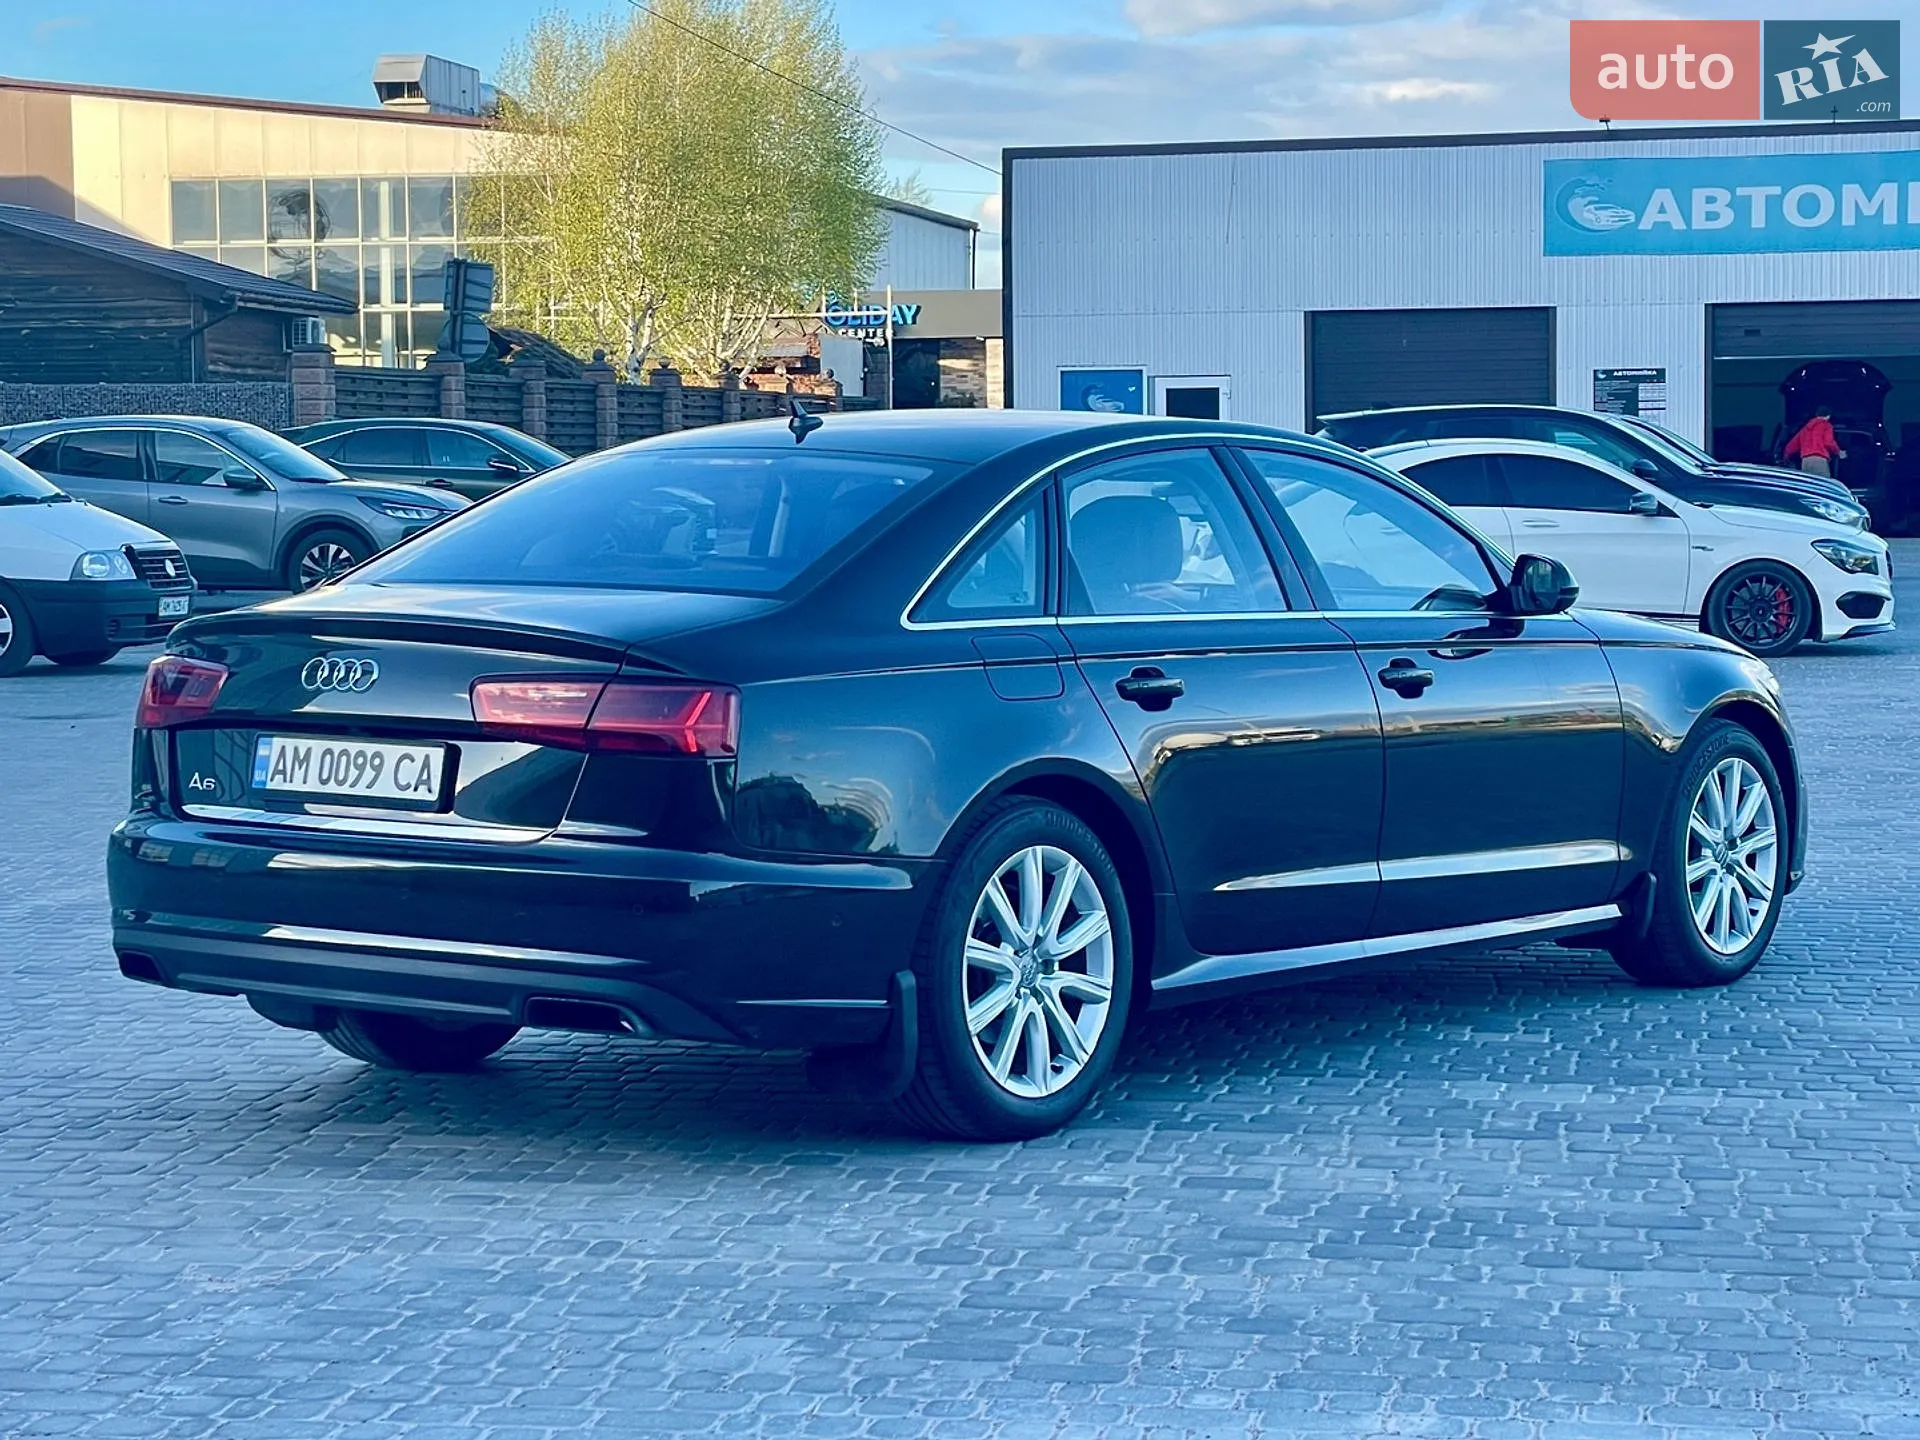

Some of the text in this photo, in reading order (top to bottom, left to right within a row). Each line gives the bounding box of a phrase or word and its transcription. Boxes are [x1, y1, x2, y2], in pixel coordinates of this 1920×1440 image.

[826, 303, 917, 326] OLIDAY
[838, 328, 892, 338] CENTE
[270, 745, 433, 794] AM 0099 CA
[188, 772, 215, 791] A6
